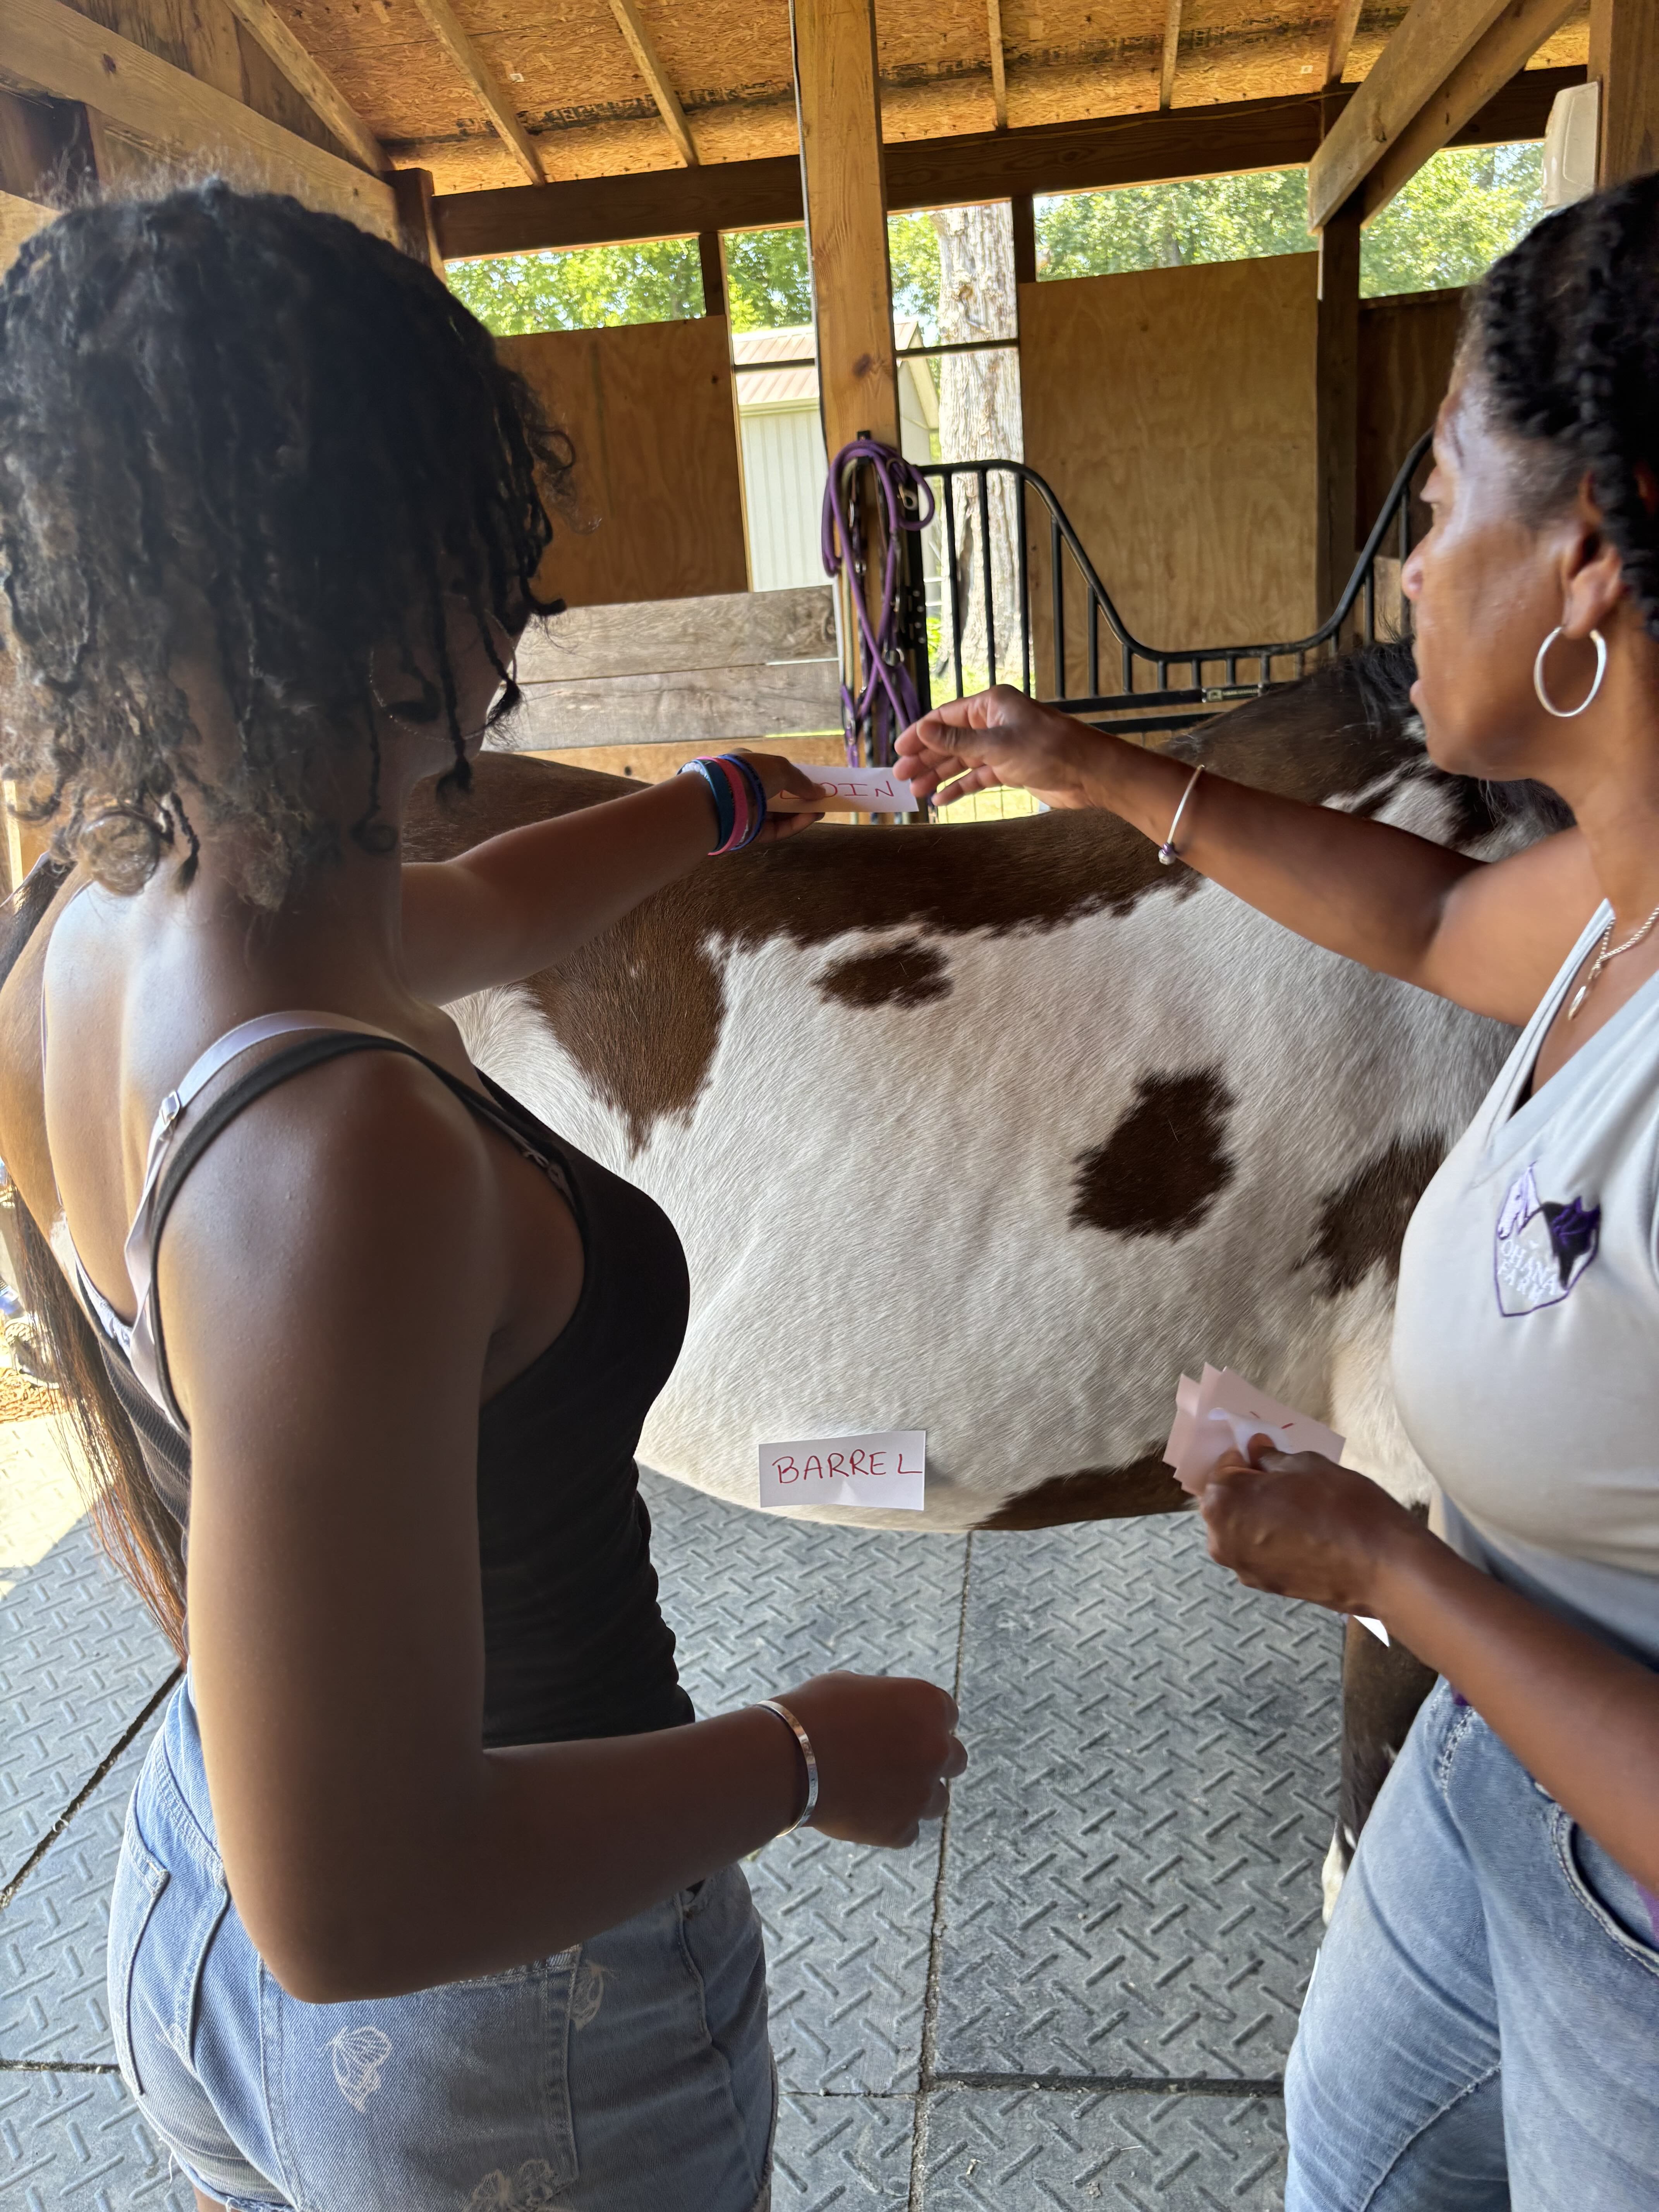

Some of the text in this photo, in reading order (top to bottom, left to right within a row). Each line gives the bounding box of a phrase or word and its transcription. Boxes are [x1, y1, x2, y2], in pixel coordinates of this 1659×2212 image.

[1497, 1259, 1545, 1305] FARM
[1500, 1239, 1558, 1295] OHANA
[772, 1448, 922, 1484] BARREL
